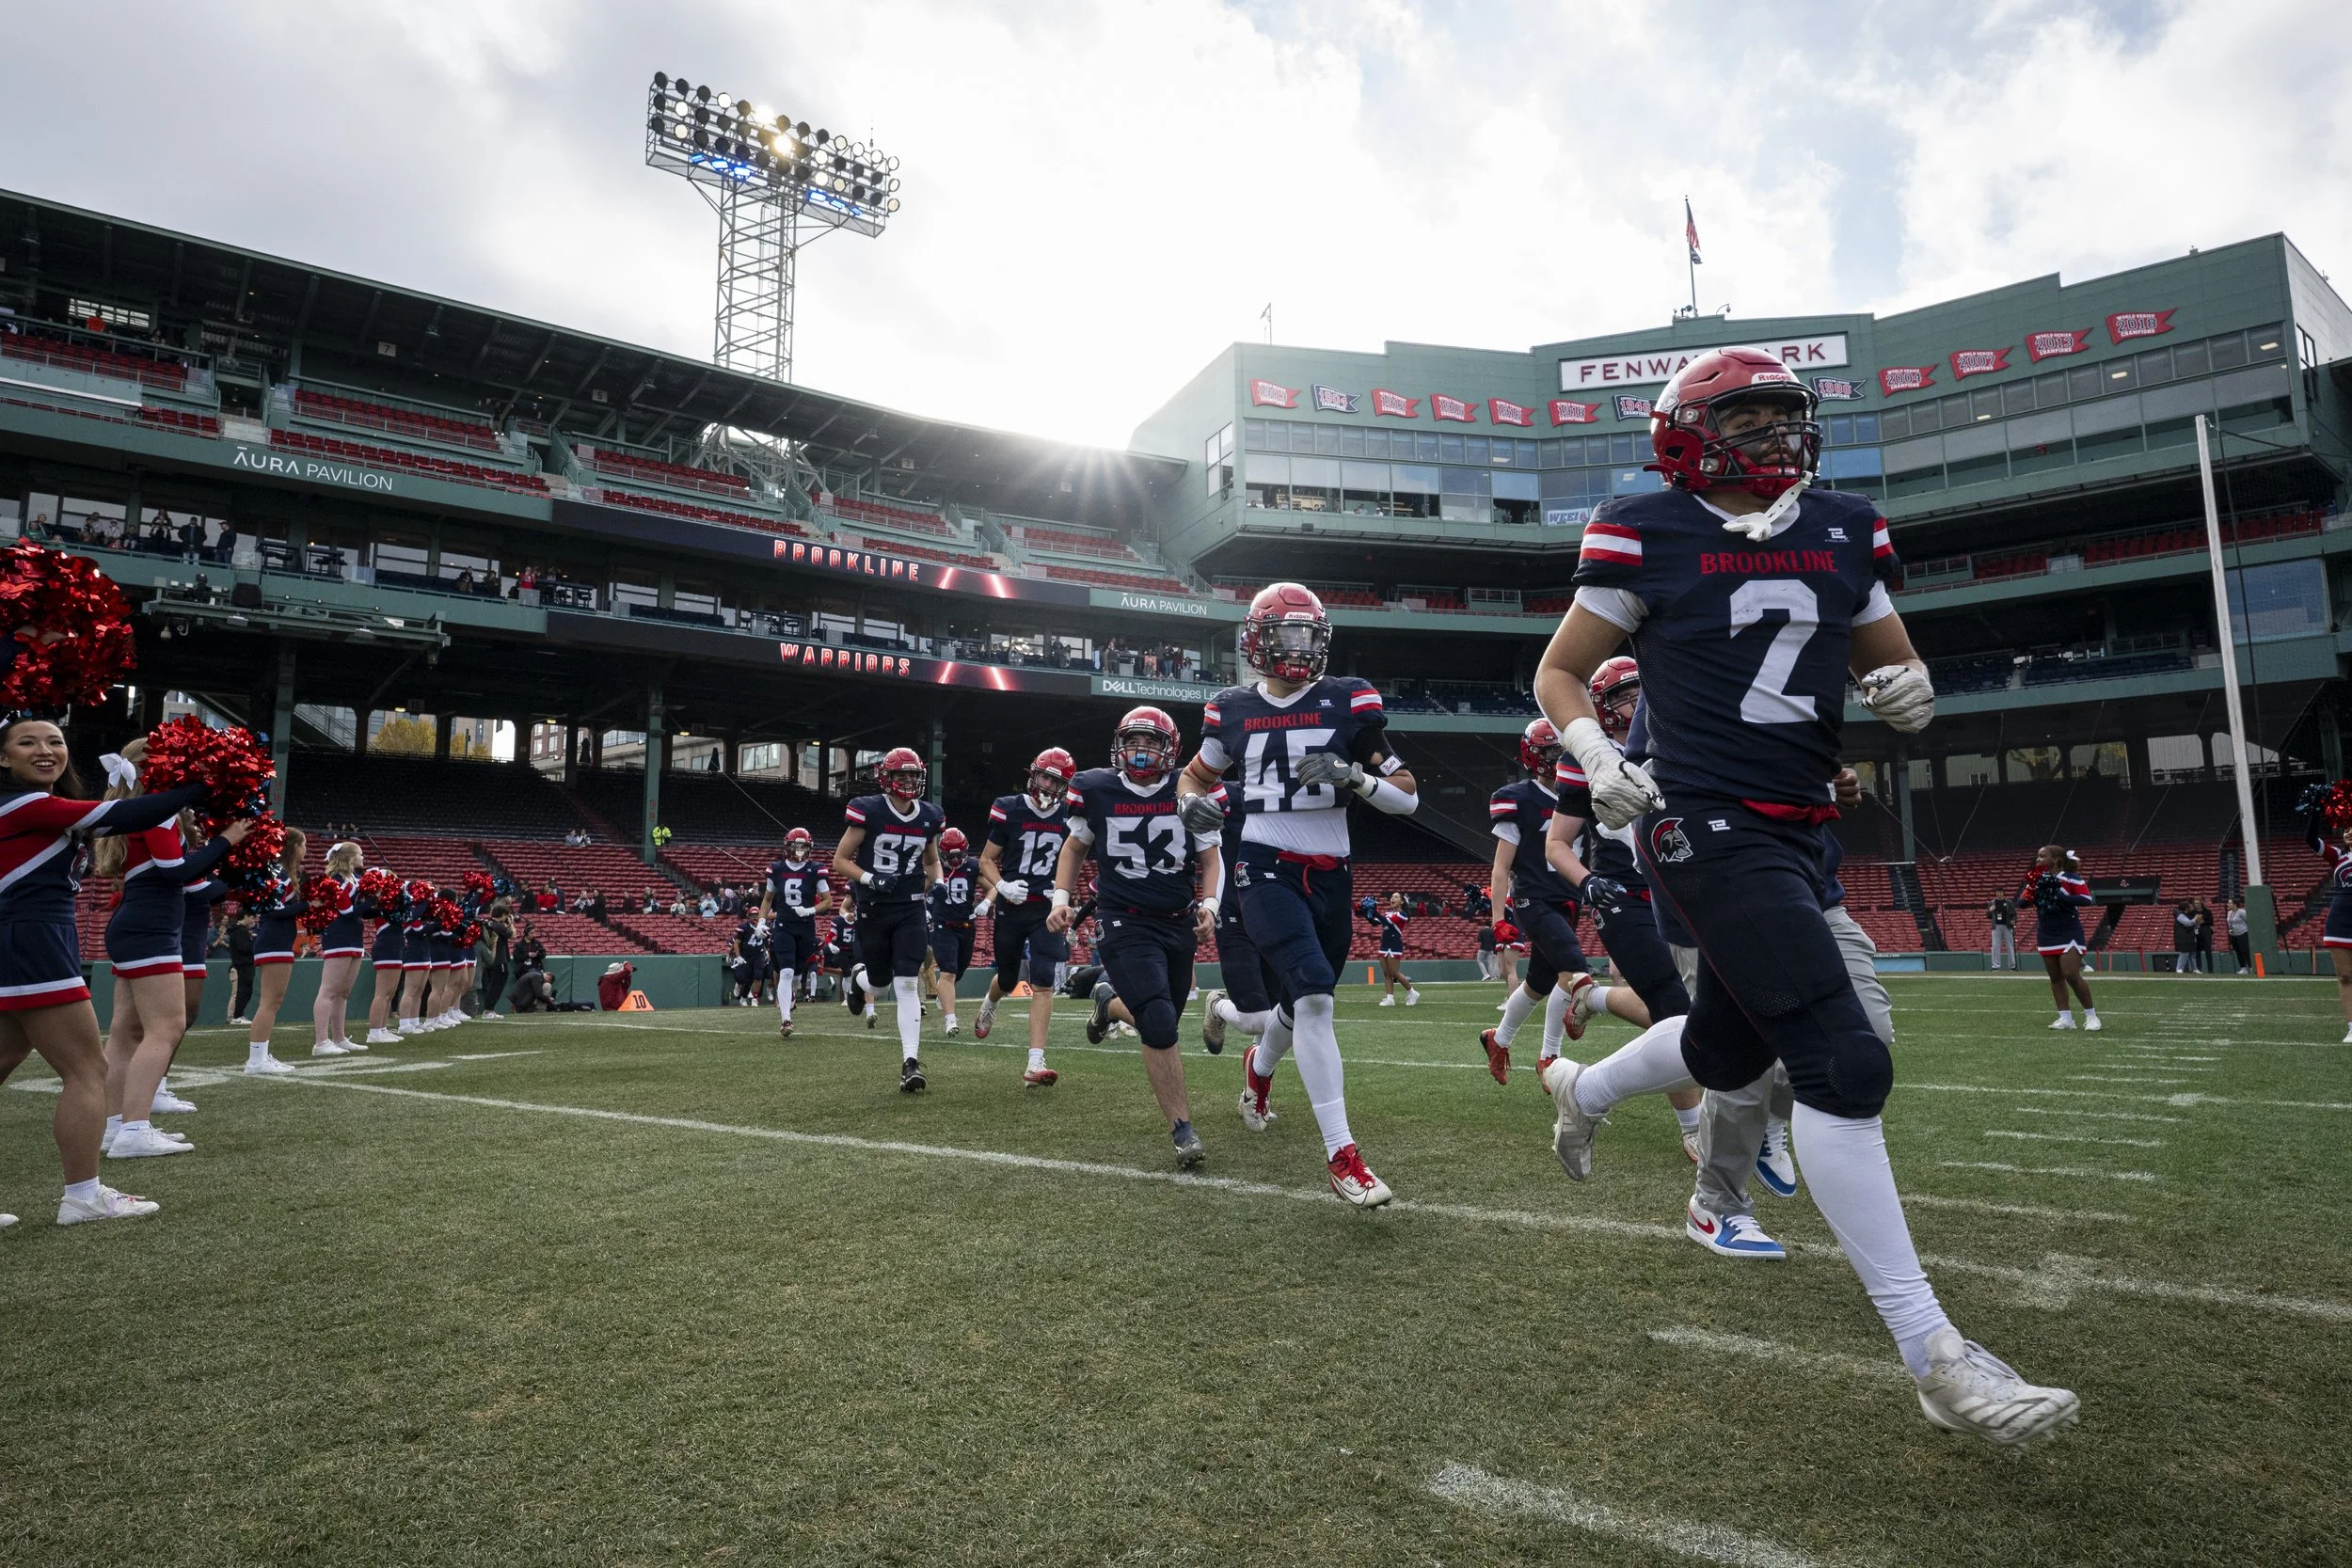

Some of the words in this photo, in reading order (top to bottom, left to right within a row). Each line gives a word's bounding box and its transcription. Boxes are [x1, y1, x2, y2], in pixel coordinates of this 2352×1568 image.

[2116, 318, 2157, 332] 2018
[2121, 328, 2155, 337] CHAMPIONS
[2035, 337, 2074, 352] 2013
[2040, 347, 2073, 356] CHAMPIONS
[1581, 356, 1690, 383] FENWA
[1781, 342, 1826, 363] RK
[1958, 356, 1995, 370] 2007
[1886, 372, 1921, 387] 2004
[1380, 395, 1406, 412] 1912
[307, 463, 393, 491] PAVILION
[773, 539, 919, 581] BROOKLINE
[1700, 550, 1838, 575] BROOKLINE
[1159, 600, 1207, 615] PAVILION
[780, 642, 911, 676] WARRIORS
[1729, 579, 1820, 724] 2
[1103, 679, 1136, 694] DELL
[1135, 682, 1201, 701] Technologies
[1244, 712, 1323, 732] BROOKLINE
[1244, 728, 1337, 813] 45
[1114, 801, 1175, 816] BROOKLINE
[873, 832, 927, 875] 67
[1018, 831, 1063, 876] 13
[1105, 815, 1186, 879] 53
[784, 878, 803, 907] 6
[632, 994, 647, 1009] 10
